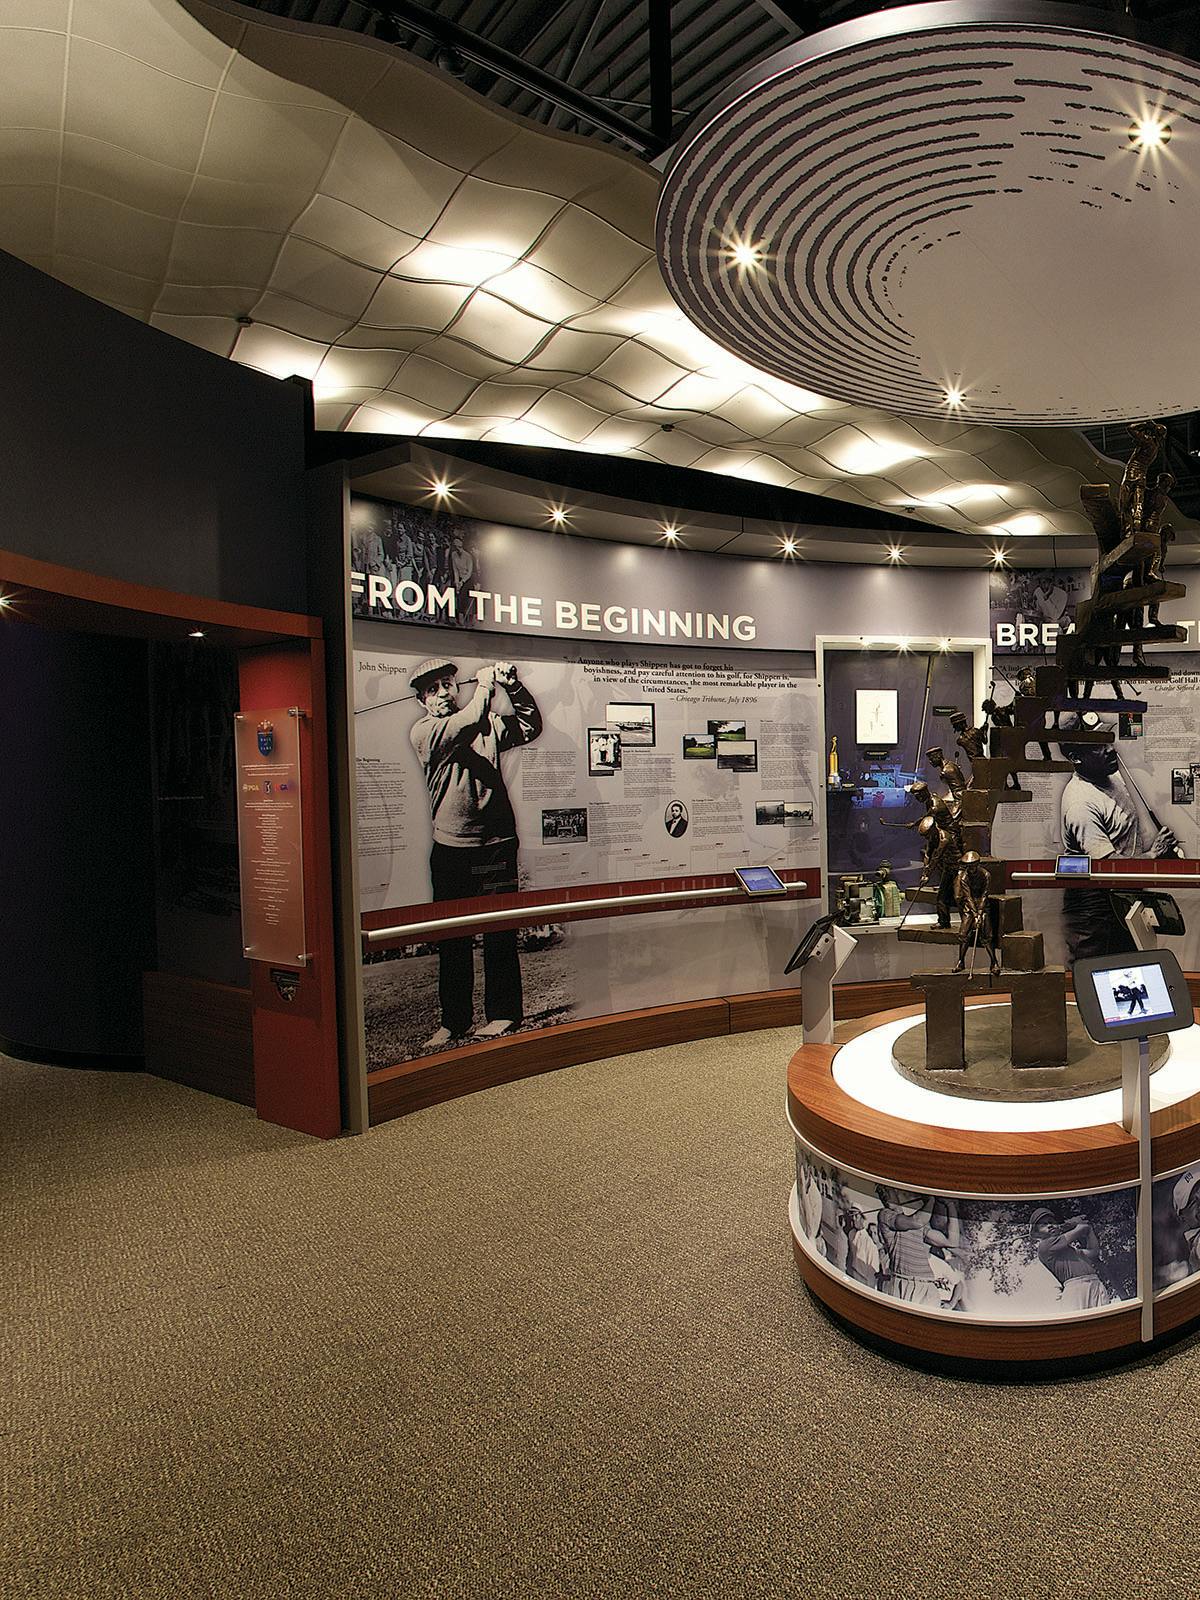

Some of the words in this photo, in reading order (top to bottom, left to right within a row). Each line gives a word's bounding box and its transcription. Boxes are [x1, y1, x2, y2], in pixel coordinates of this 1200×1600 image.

[468, 590, 542, 627] THE
[555, 600, 756, 641] BEGINNING
[358, 661, 376, 673] John
[377, 663, 407, 675] Shippen
[578, 657, 605, 666] Anyone
[621, 660, 638, 668] plays
[640, 660, 668, 669] Shippen
[703, 663, 723, 671] forget
[727, 672, 741, 680] golf,
[753, 673, 780, 681] Shippen
[1182, 668, 1200, 676] down
[620, 675, 627, 683] of
[640, 677, 689, 686] circumstances,
[758, 681, 777, 689] player
[642, 685, 665, 693] United
[676, 695, 700, 704] Chicago
[728, 696, 740, 704] July
